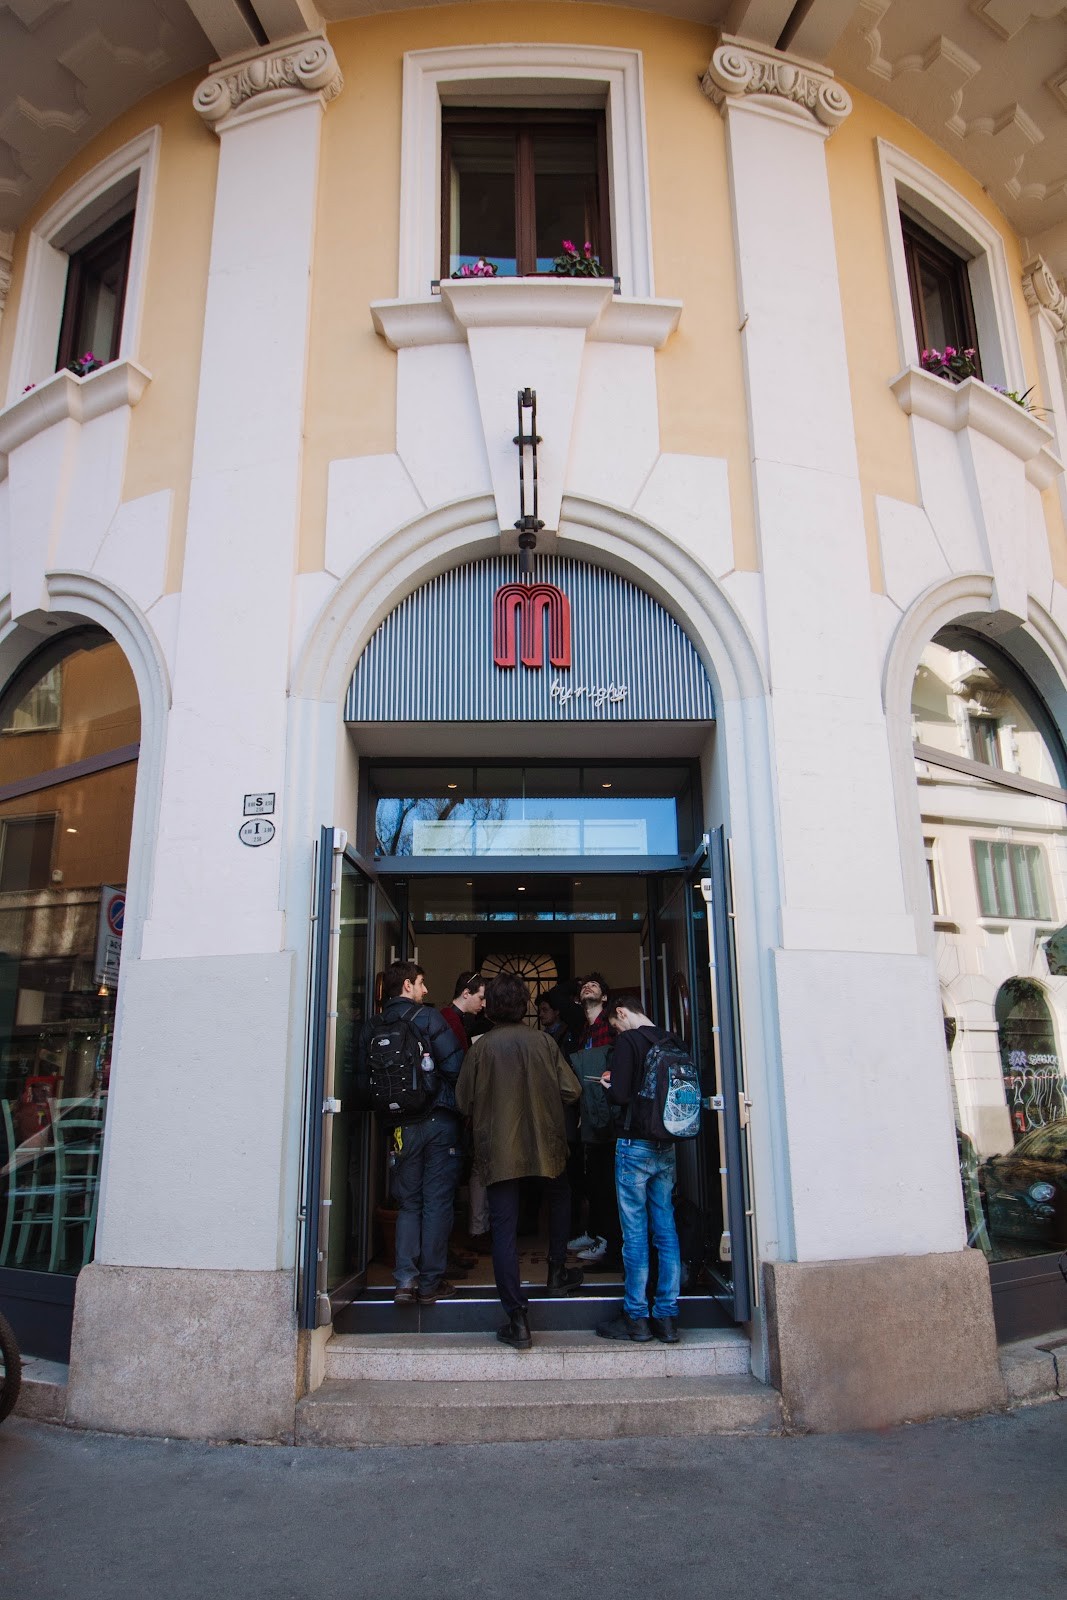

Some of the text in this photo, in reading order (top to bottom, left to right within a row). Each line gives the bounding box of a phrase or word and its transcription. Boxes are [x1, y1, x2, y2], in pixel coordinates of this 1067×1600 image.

[550, 678, 628, 707] by night
[256, 797, 263, 806] S
